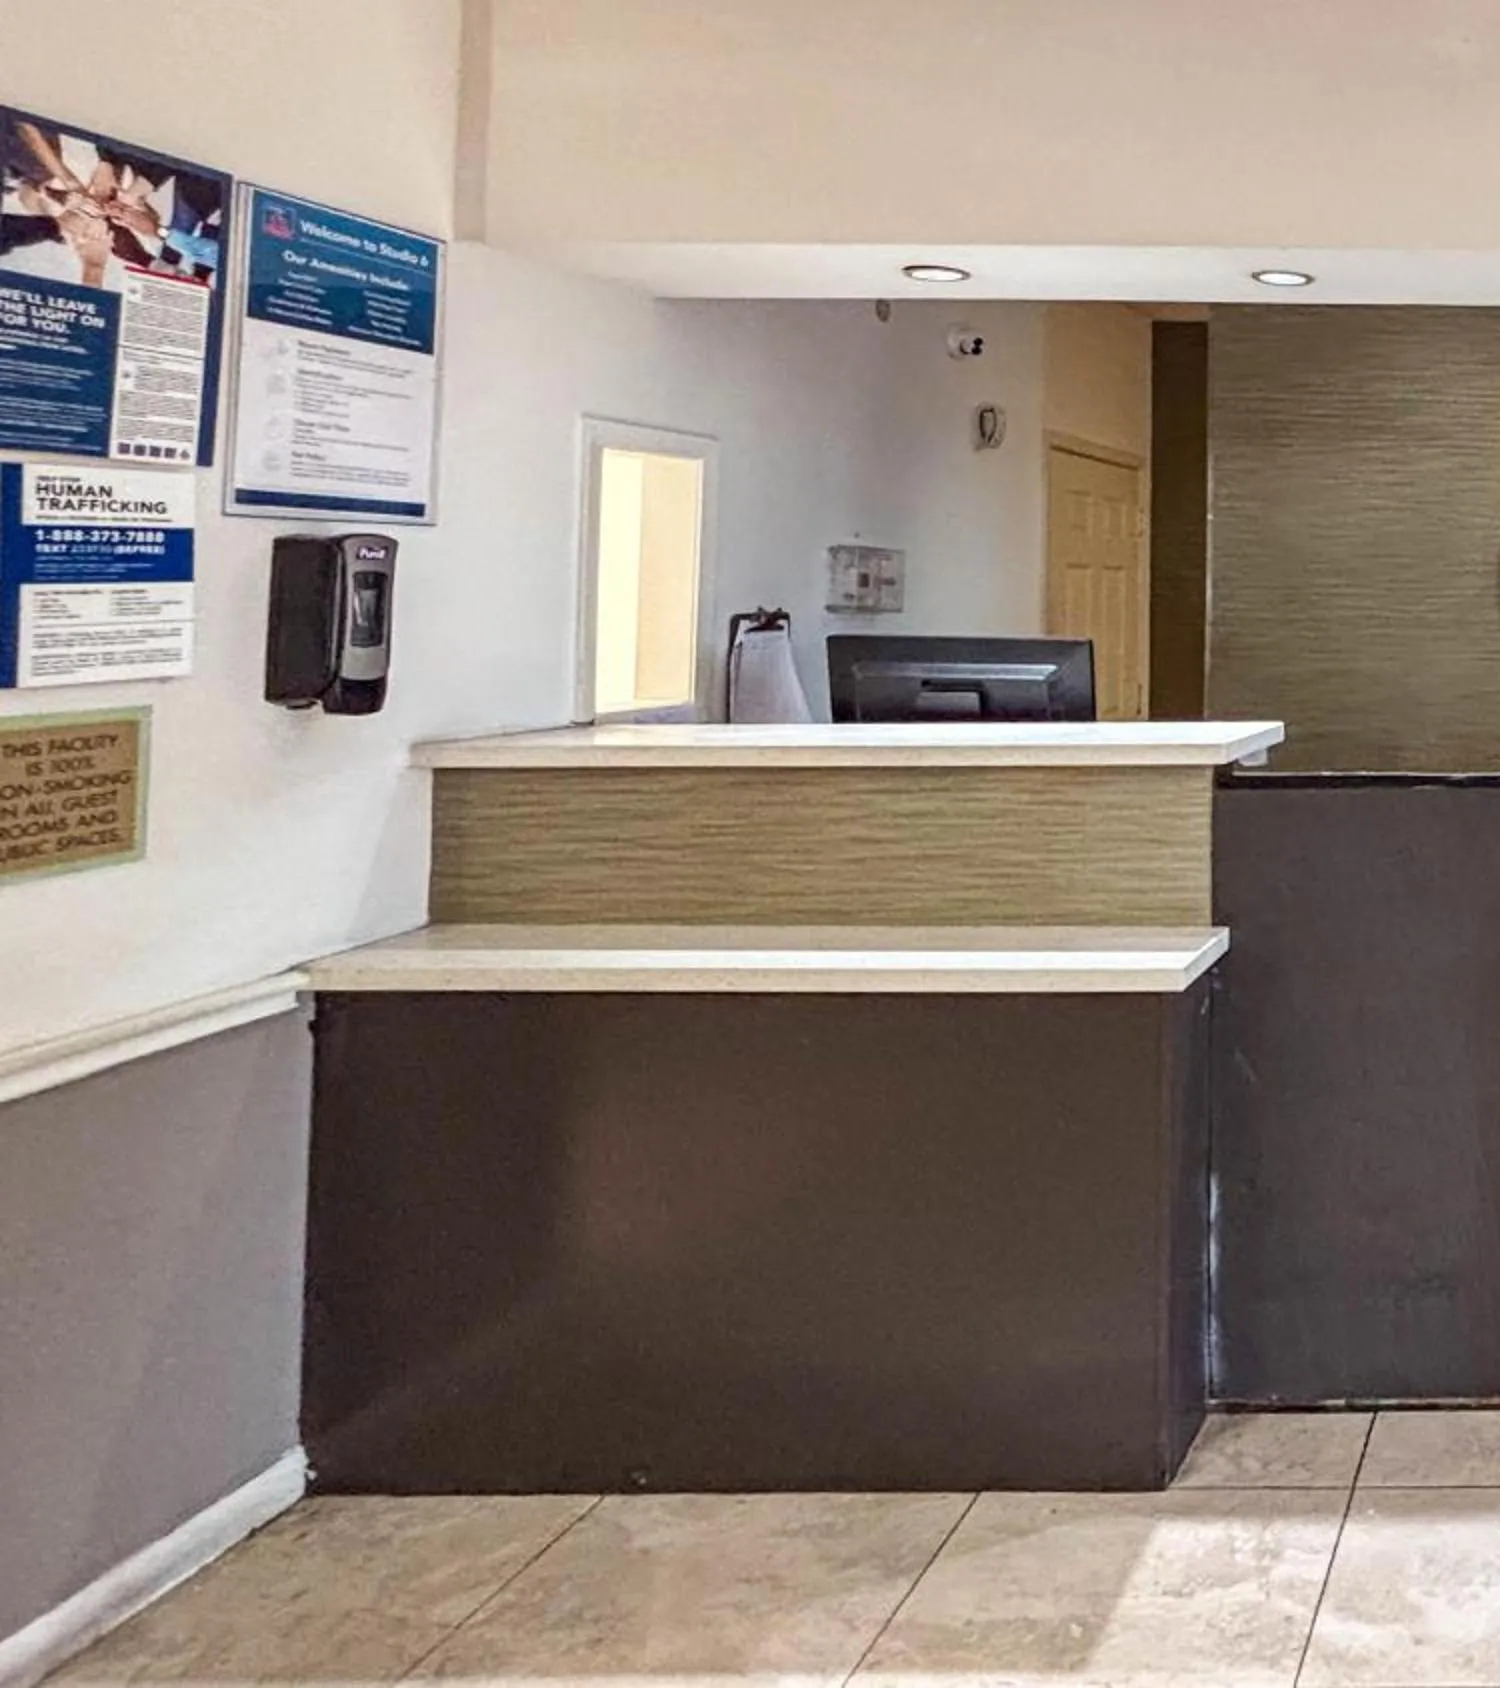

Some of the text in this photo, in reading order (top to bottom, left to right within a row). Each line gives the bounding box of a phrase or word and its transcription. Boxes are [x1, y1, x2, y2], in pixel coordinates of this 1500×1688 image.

[300, 220, 361, 248] Welcome
[48, 295, 96, 315] LEAVE
[30, 305, 76, 322] LIGHT
[80, 315, 105, 328] ON
[36, 483, 113, 498] HUMAN
[36, 497, 168, 514] TRAFFICKING
[49, 734, 119, 754] FACILITY
[0, 769, 133, 802] ON-SMOKING
[76, 810, 117, 828] AND
